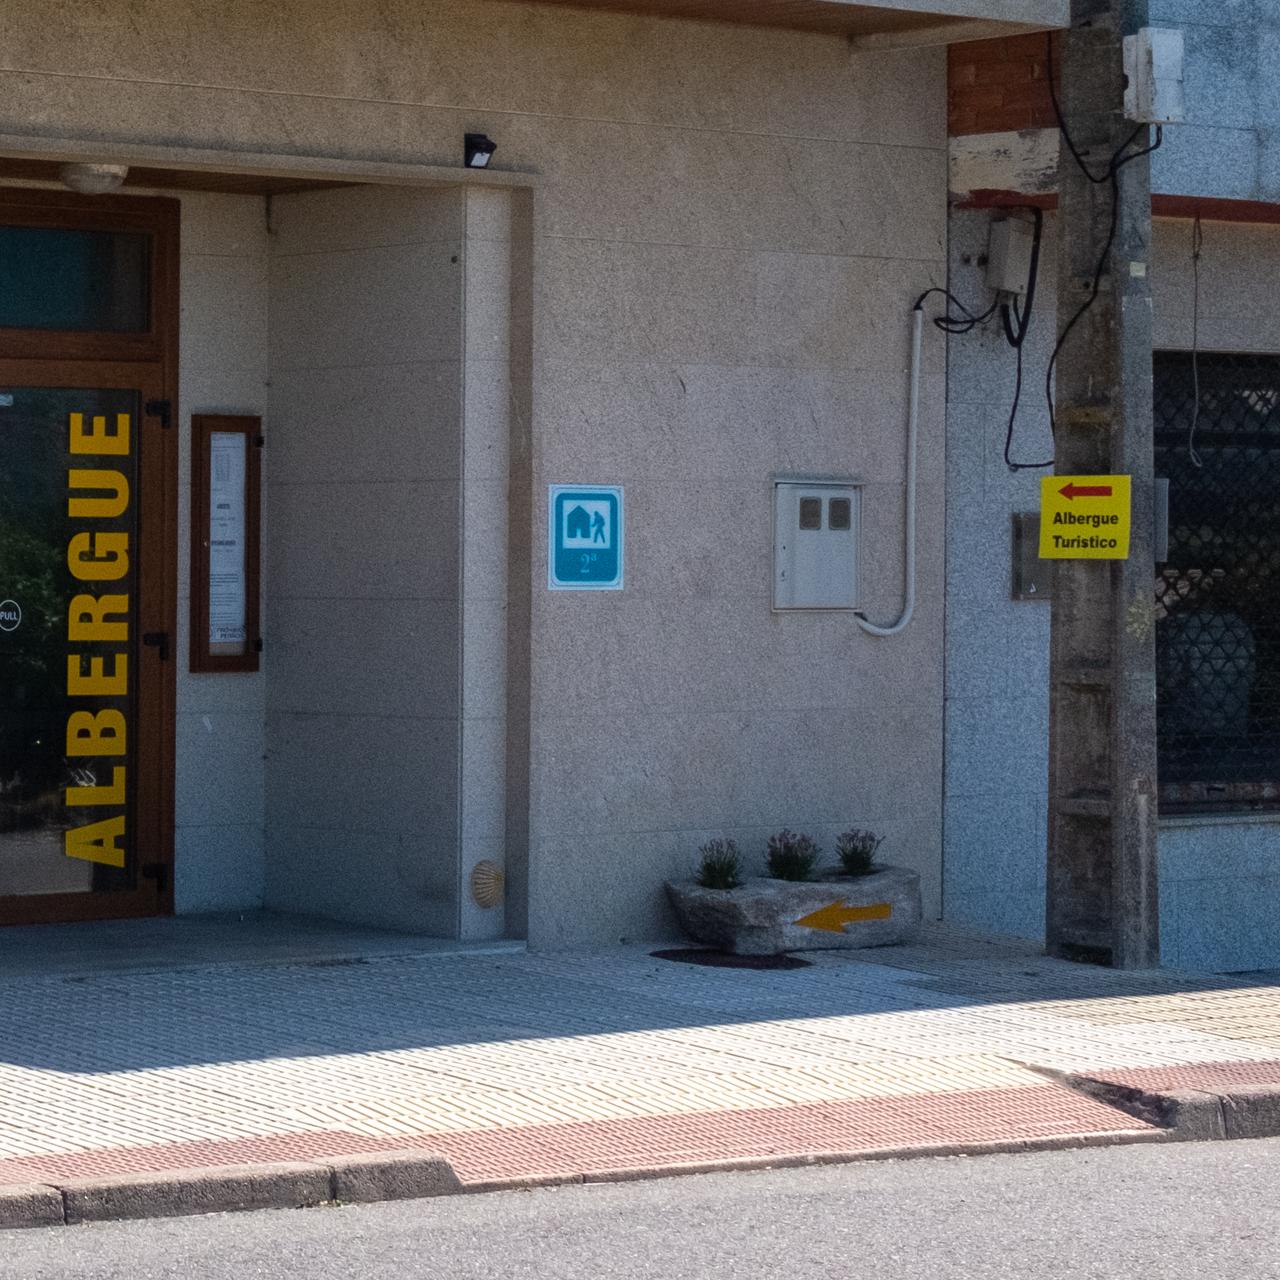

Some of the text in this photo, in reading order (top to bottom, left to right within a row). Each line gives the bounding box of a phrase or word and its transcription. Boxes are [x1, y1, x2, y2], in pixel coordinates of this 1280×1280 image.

[1053, 511, 1120, 528] Albergue
[0, 611, 17, 622] PULL
[65, 412, 130, 868] ALBERGUE
